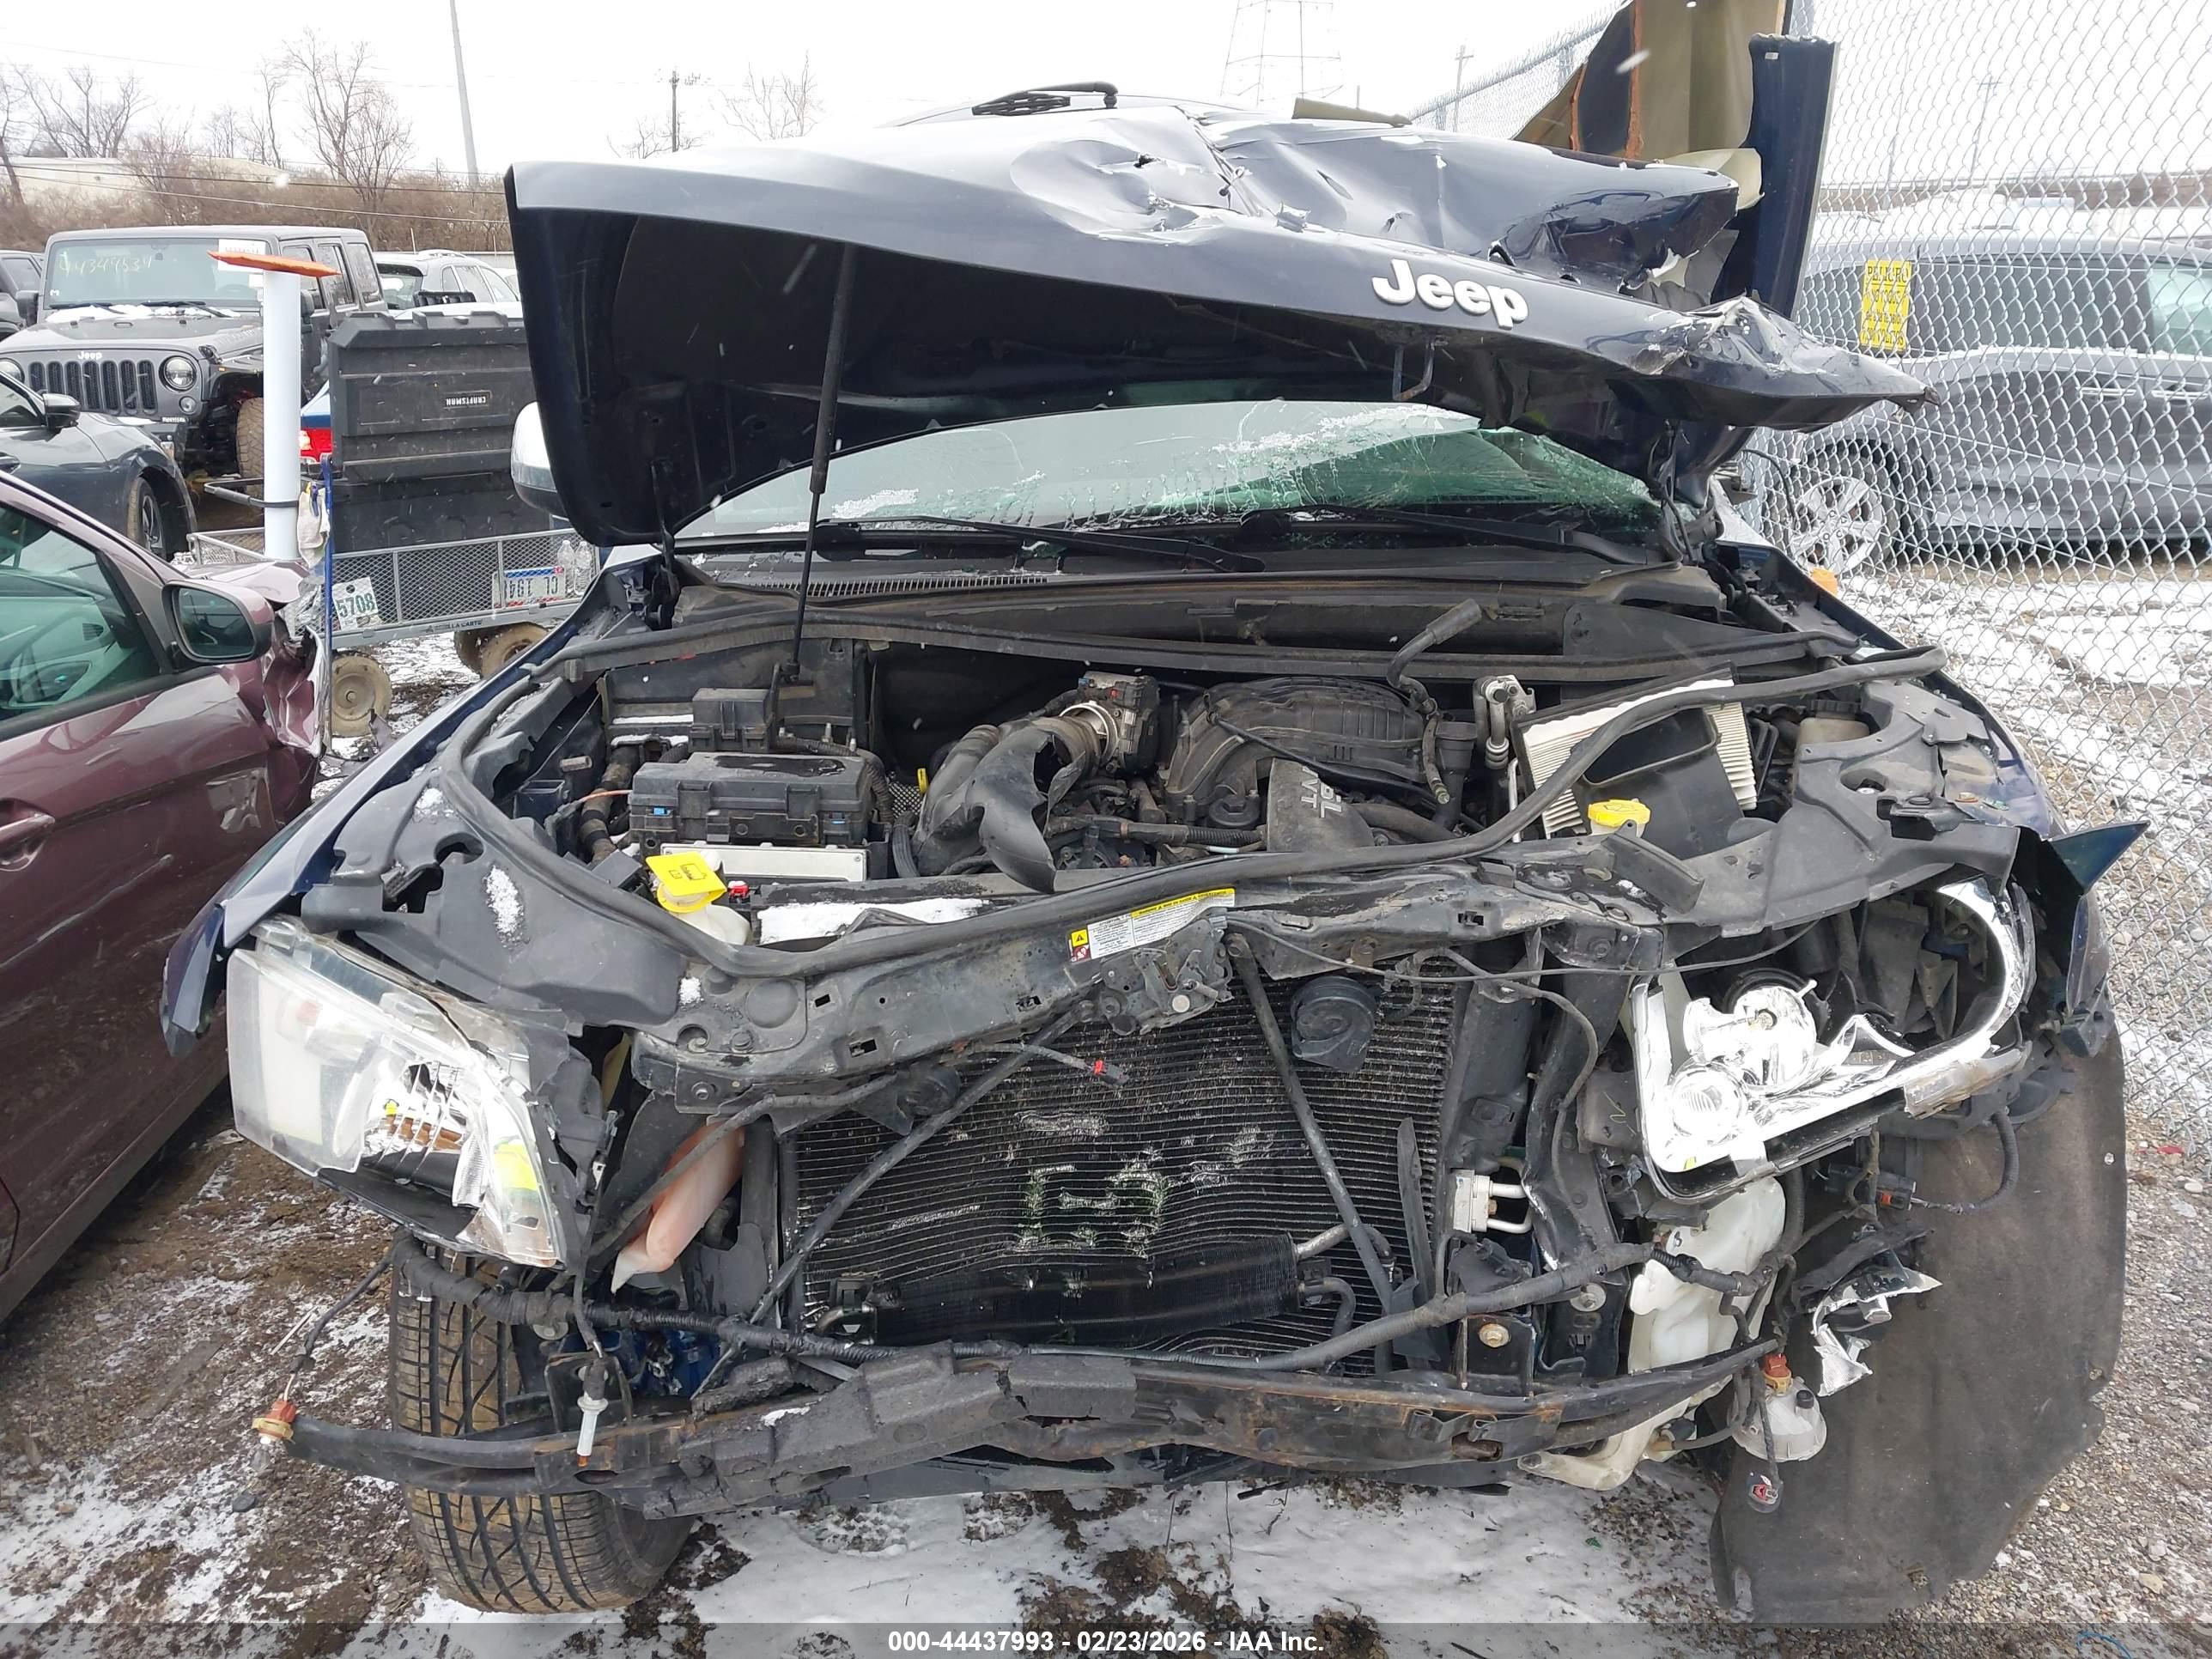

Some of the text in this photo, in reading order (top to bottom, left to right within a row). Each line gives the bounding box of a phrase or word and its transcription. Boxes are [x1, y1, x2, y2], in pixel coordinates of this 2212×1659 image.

[1371, 258, 1528, 331] Jeep
[77, 351, 102, 361] Jeep
[446, 396, 486, 406] CRAFTSMAN
